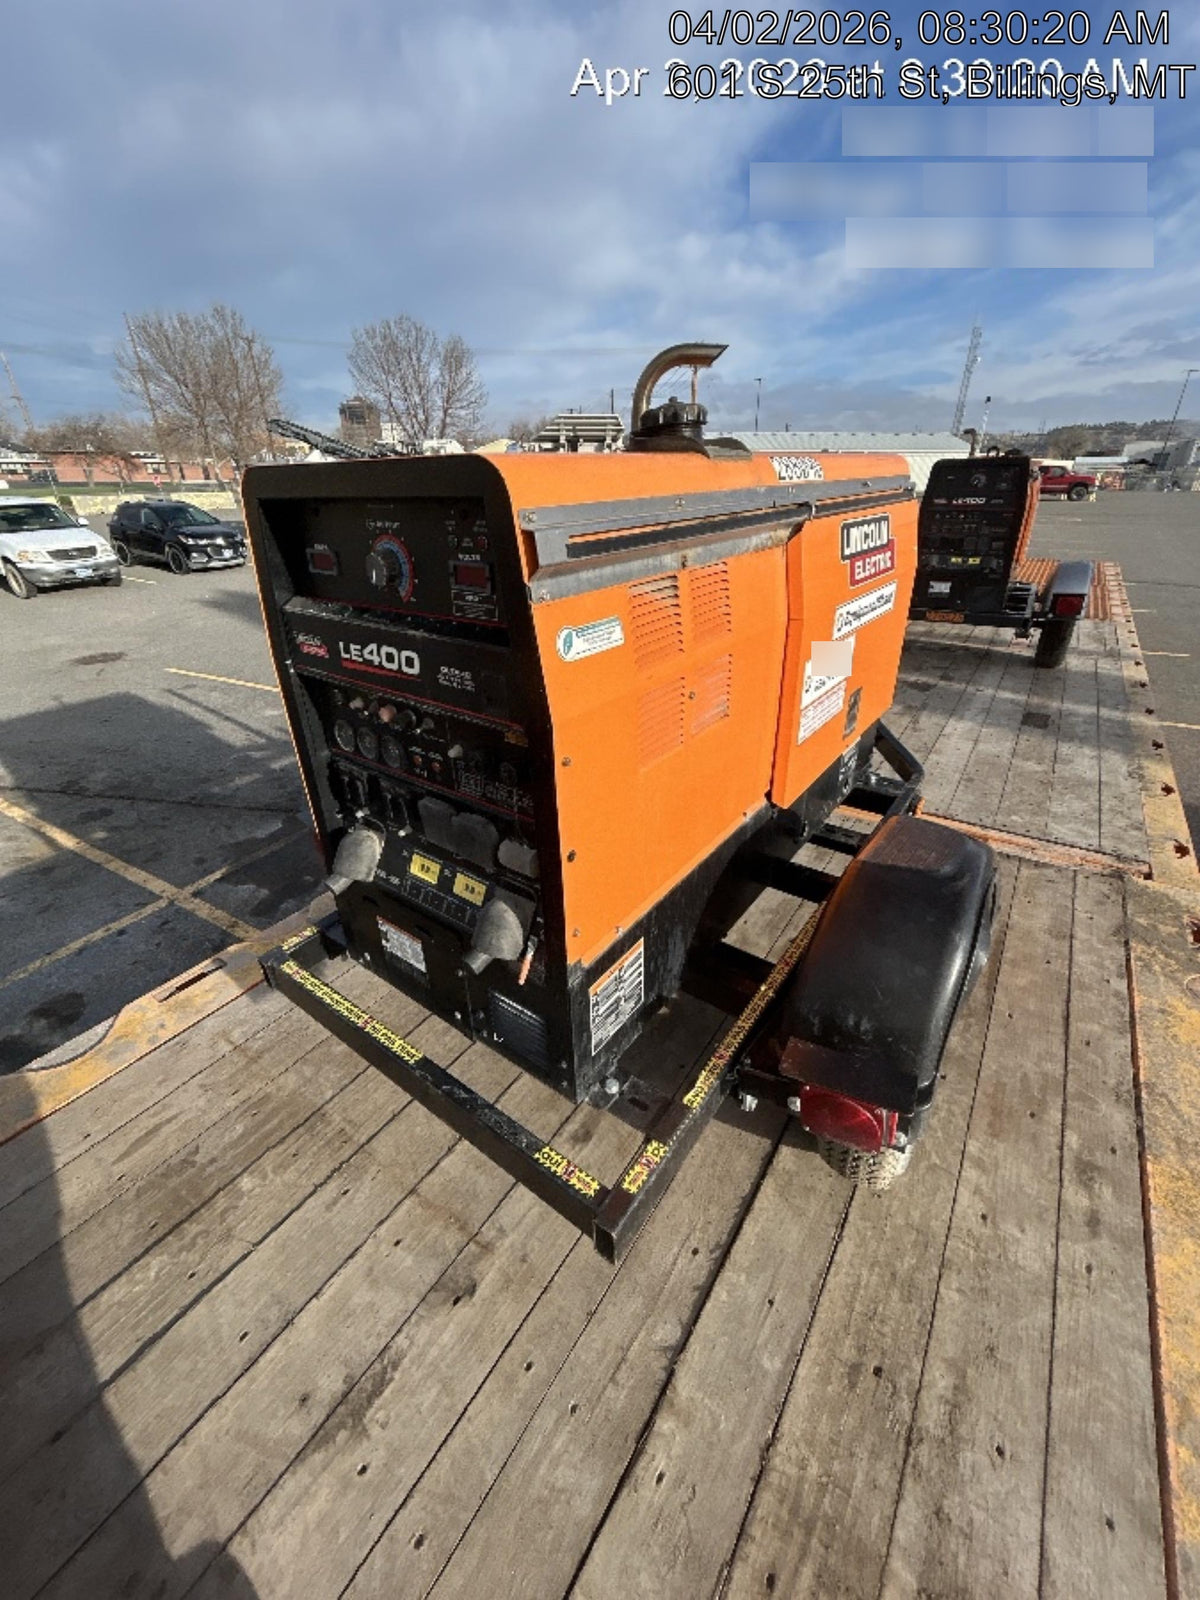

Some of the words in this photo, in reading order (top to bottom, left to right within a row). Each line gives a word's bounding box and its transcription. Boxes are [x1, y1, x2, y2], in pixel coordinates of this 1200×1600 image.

[844, 520, 888, 555] LINCOLN
[855, 551, 891, 580] ELECTRIC
[339, 641, 420, 675] LE400
